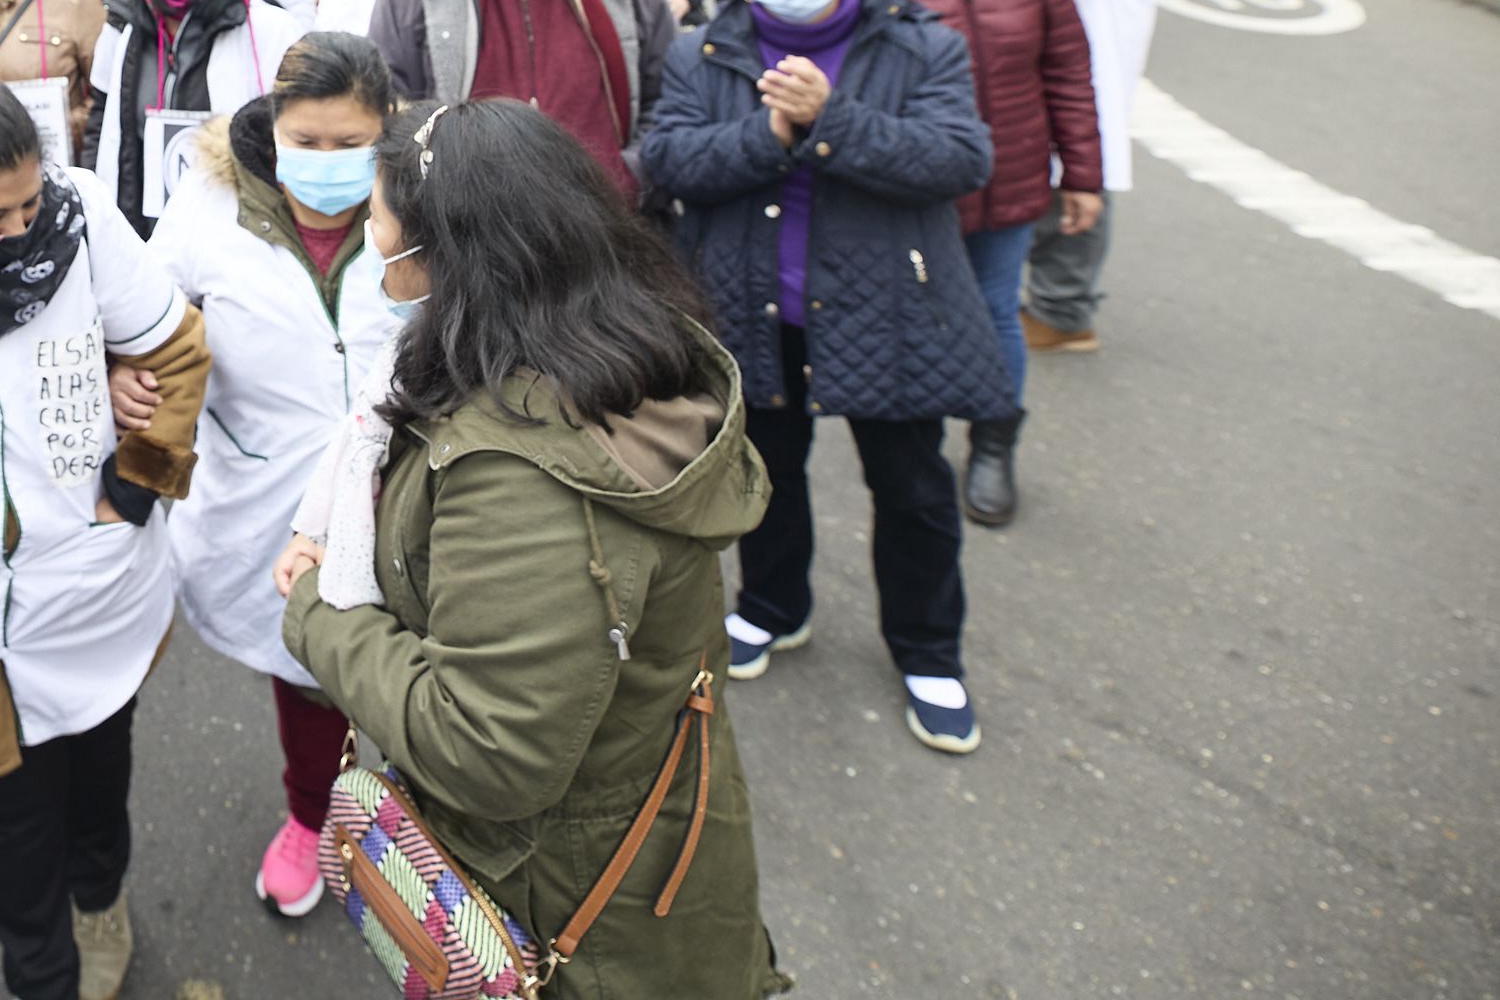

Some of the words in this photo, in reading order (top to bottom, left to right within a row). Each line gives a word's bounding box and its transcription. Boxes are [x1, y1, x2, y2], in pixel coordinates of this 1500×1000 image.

[65, 332, 100, 366] SA
[39, 397, 106, 428] CALLE
[47, 427, 99, 450] POR
[53, 455, 100, 478] DER
